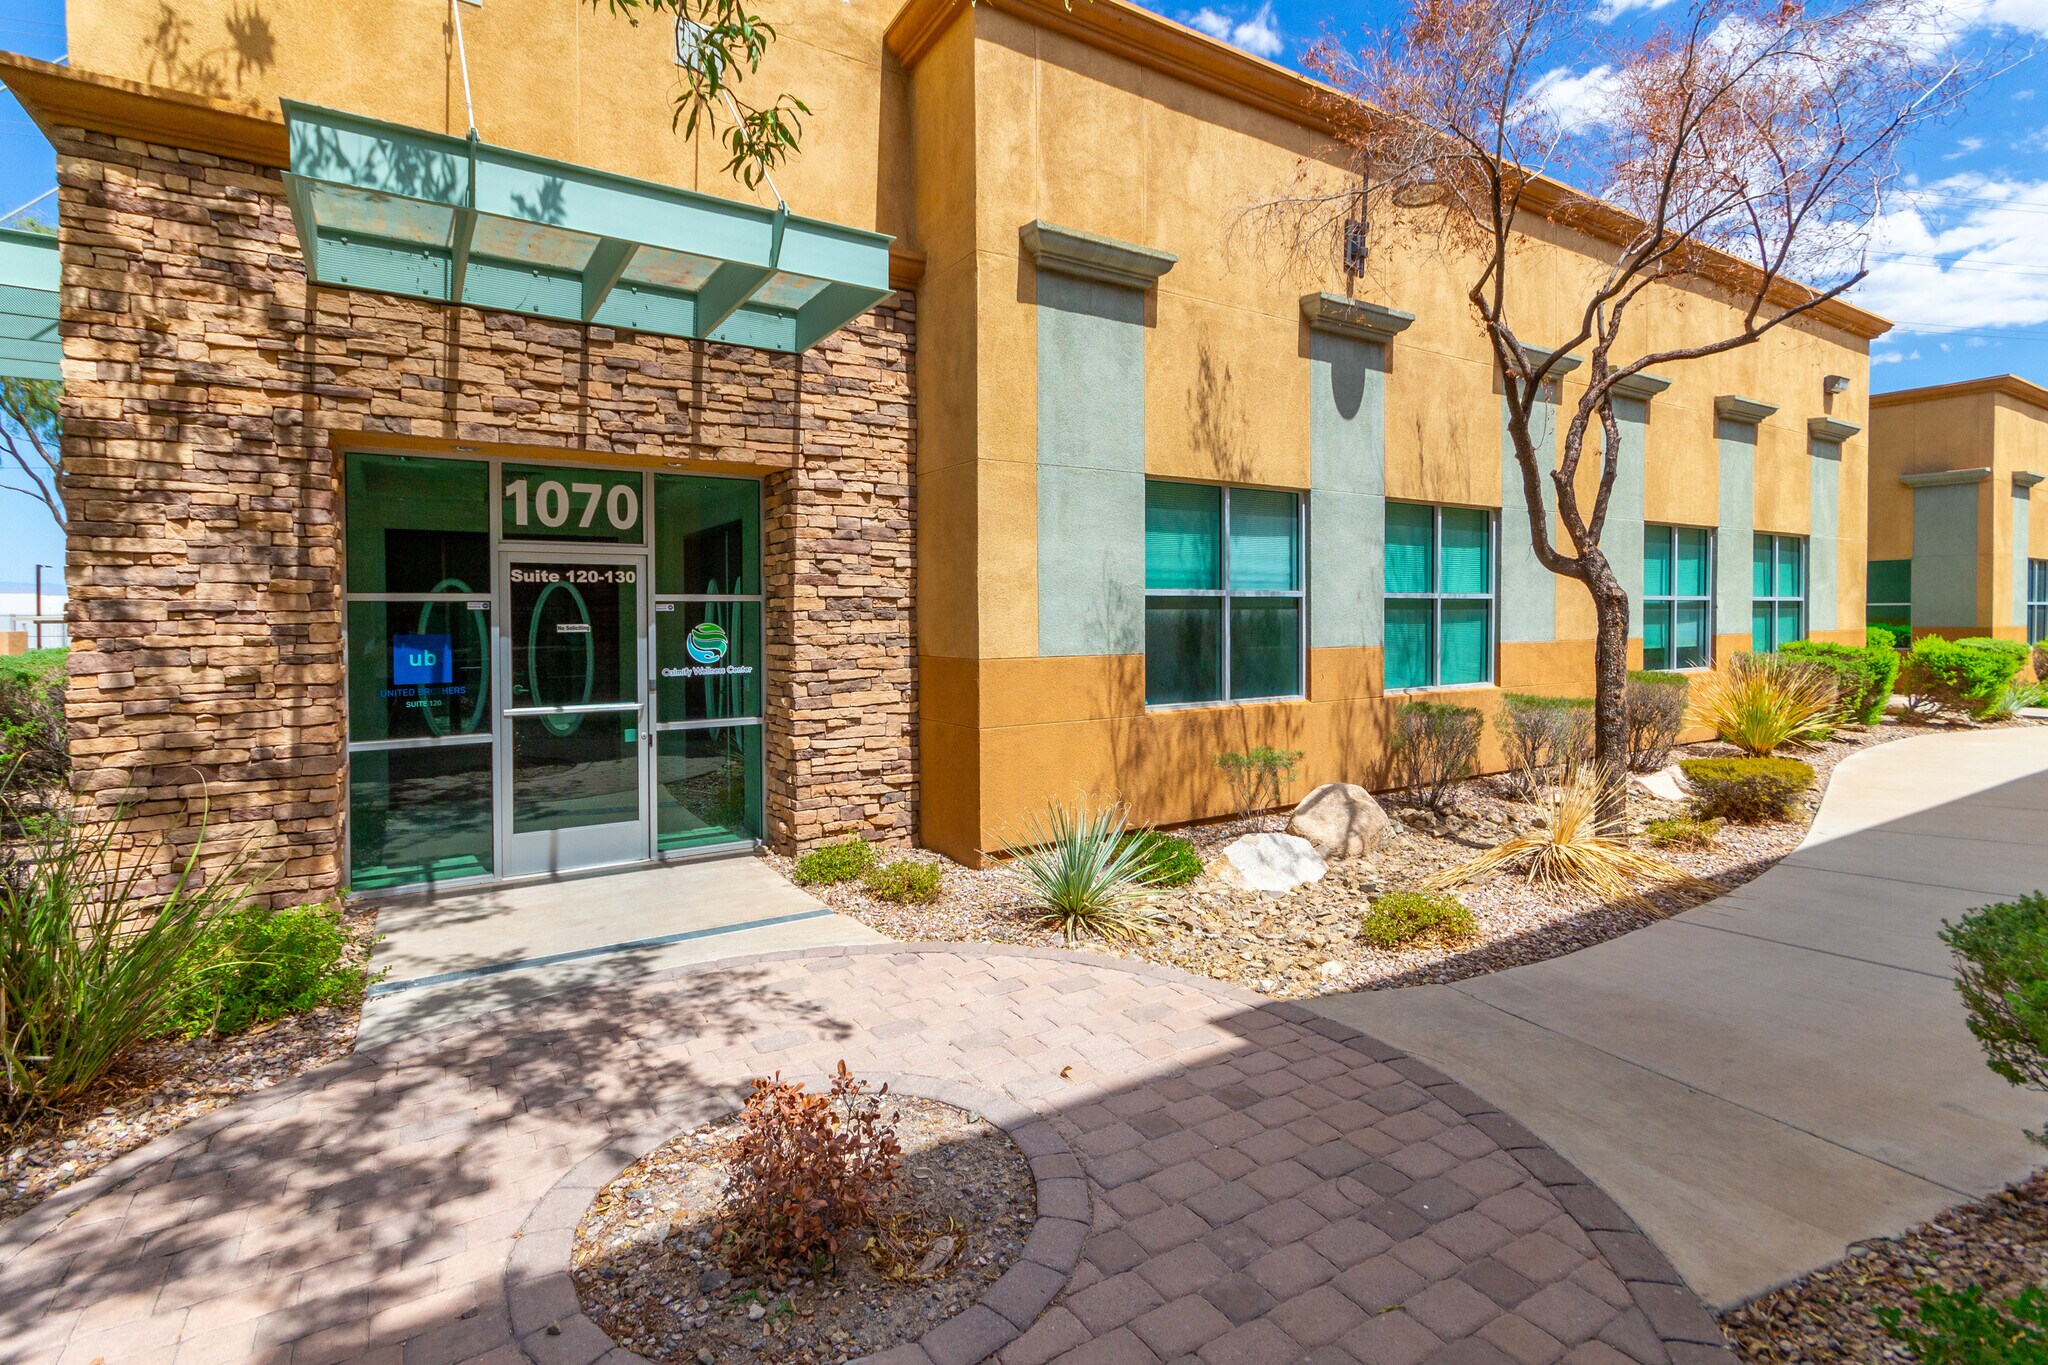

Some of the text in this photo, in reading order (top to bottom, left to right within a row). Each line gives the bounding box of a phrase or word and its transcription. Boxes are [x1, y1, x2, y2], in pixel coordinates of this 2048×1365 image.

[505, 479, 639, 530] 1070
[510, 569, 636, 584] Suite 120-130
[409, 649, 437, 667] ub
[661, 664, 753, 678] Calmify Wellness Center
[380, 688, 415, 698] UNITED
[405, 699, 442, 708] SUITE 120
